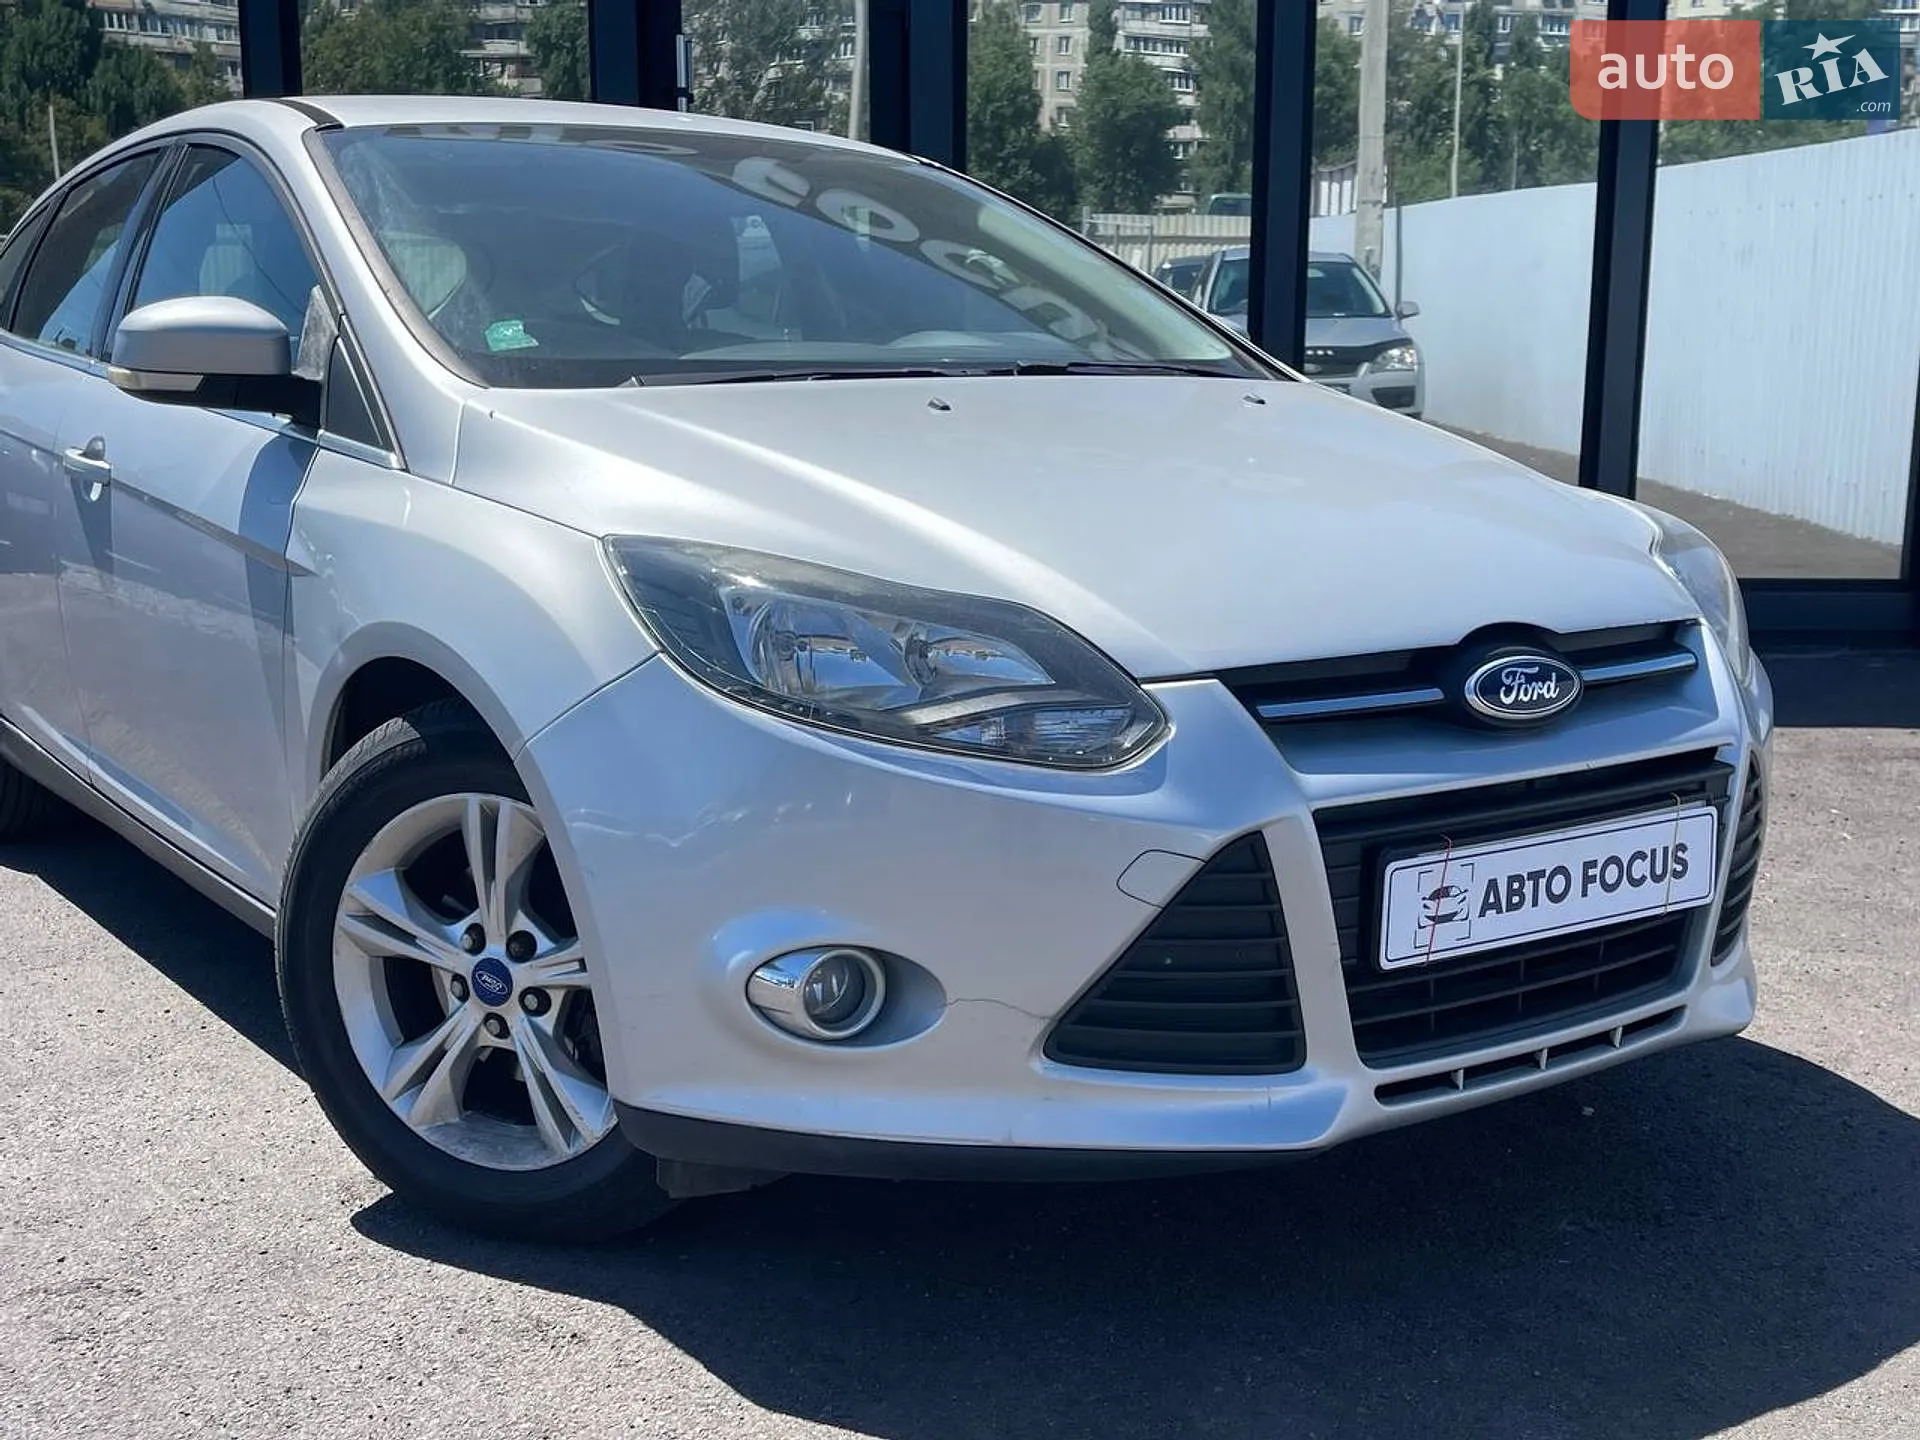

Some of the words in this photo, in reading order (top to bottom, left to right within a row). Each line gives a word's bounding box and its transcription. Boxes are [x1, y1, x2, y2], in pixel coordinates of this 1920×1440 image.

[1500, 666, 1560, 705] Ford
[1478, 864, 1572, 918] АВТО
[1581, 842, 1689, 898] FOCUS
